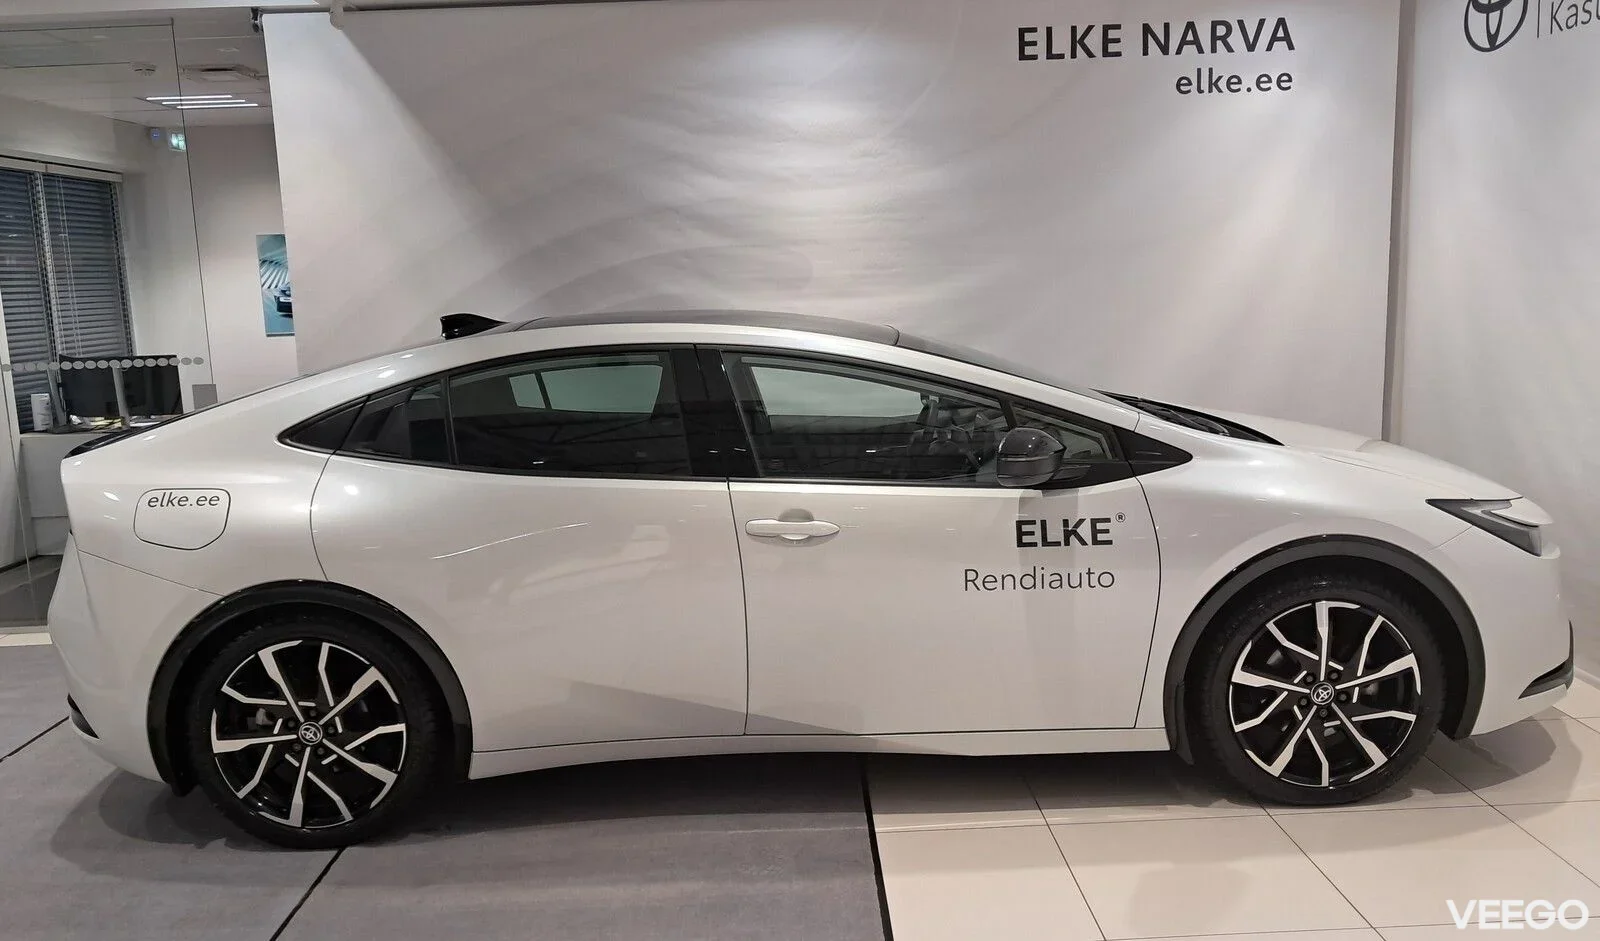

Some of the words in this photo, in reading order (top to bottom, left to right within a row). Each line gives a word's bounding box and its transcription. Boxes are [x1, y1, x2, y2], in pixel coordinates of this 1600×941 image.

[1018, 24, 1122, 61] ELKE
[1142, 17, 1296, 57] NARVA
[1175, 67, 1293, 95] elke.ee
[147, 491, 220, 508] elke.ee
[964, 566, 1115, 591] Rendiauto
